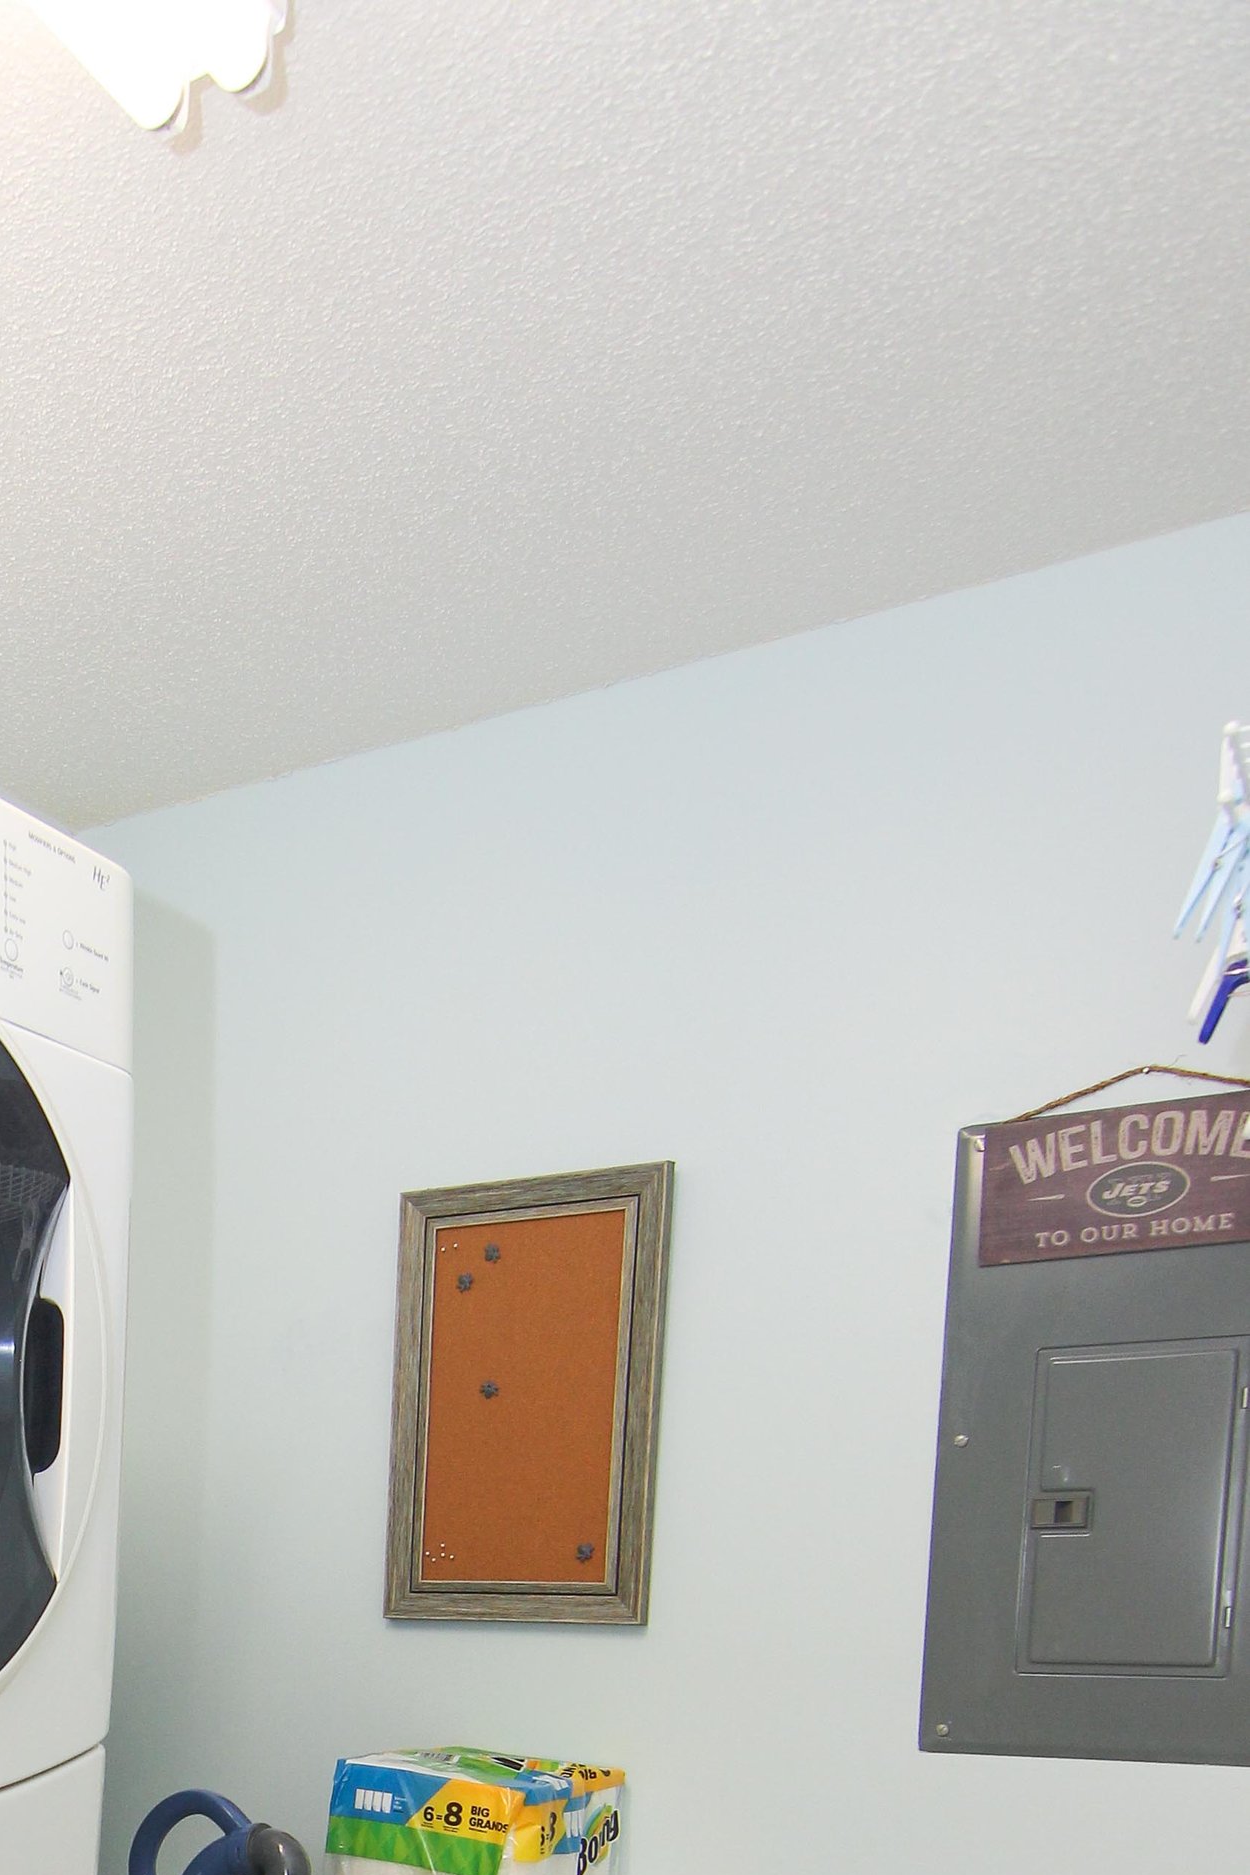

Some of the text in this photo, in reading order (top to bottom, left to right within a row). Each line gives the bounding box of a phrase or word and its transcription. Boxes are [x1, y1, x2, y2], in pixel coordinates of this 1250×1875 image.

[1102, 1180, 1171, 1200] JETS
[1035, 1212, 1236, 1248] TO OUR HOME
[470, 1805, 490, 1818] BIG
[468, 1816, 509, 1834] GRANDS
